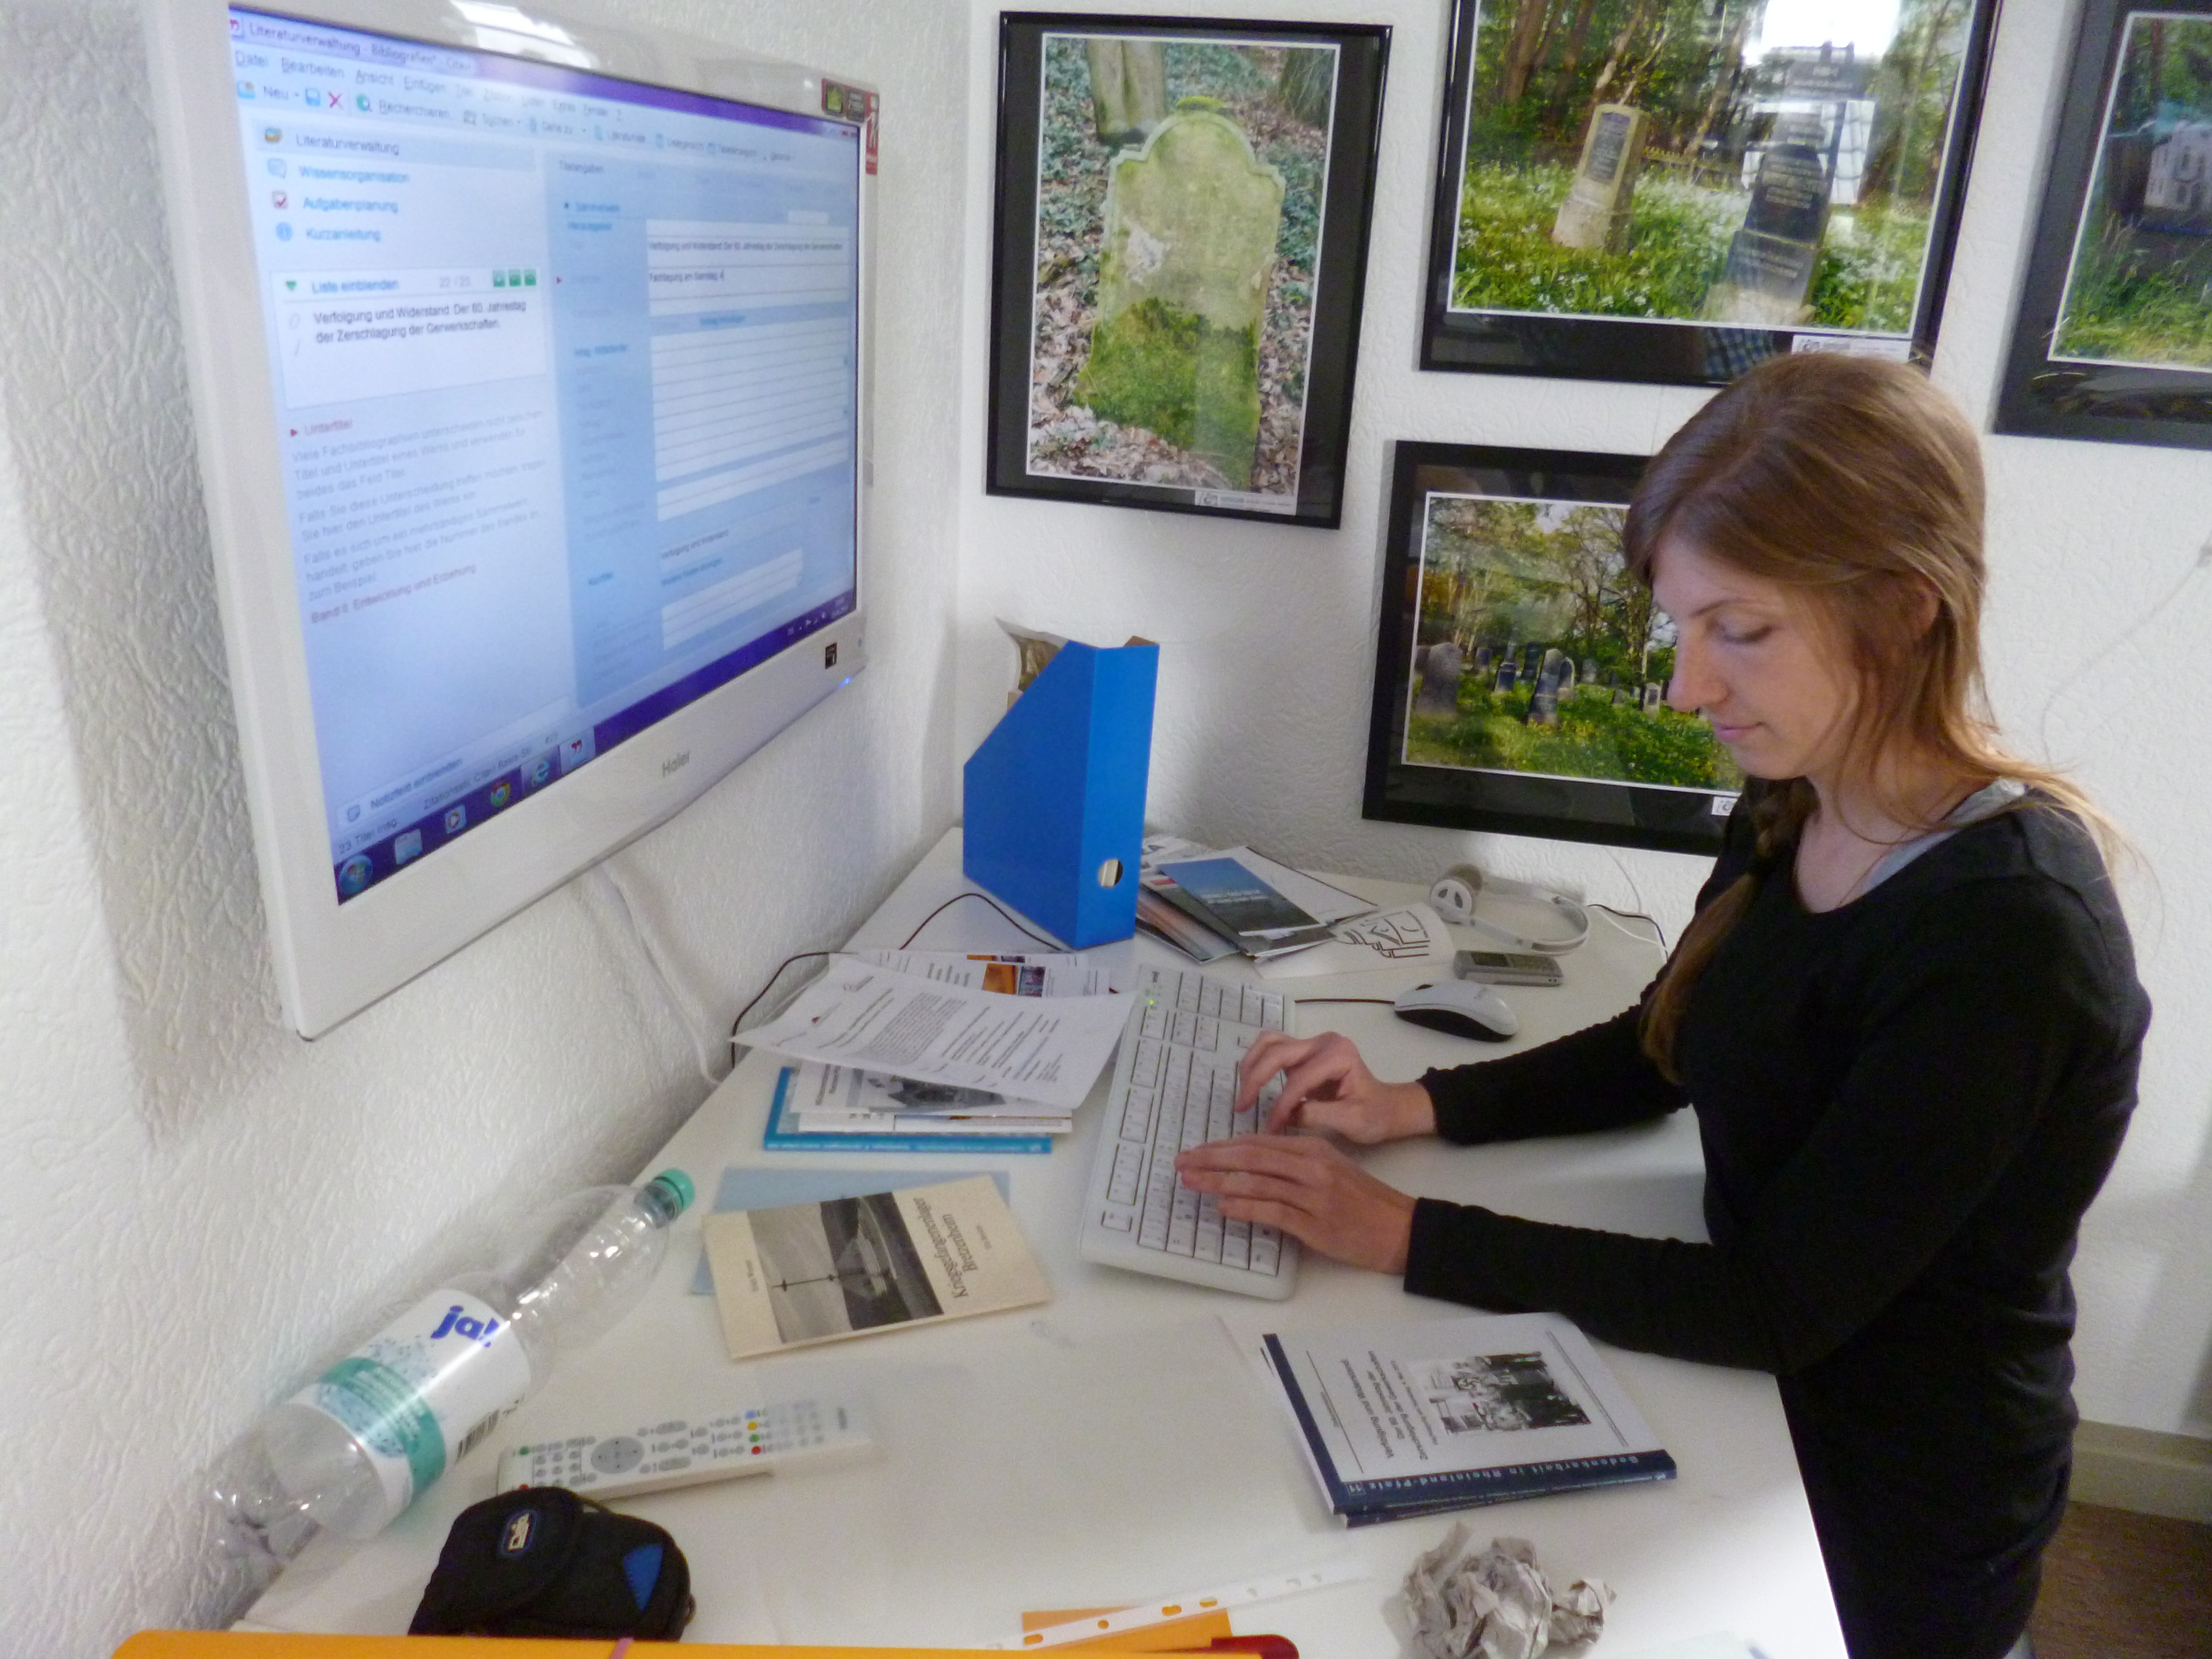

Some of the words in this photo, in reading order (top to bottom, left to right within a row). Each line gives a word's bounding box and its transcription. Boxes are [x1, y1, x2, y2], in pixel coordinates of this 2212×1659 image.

[235, 50, 269, 71] Datei
[281, 57, 344, 81] Bearbeiten
[355, 69, 394, 88] Ansicht
[404, 76, 446, 95] Einfügen
[264, 86, 290, 103] Neu
[296, 134, 399, 157] Literaturverwaltung
[298, 164, 410, 184] Wissensorganisation
[303, 196, 398, 214] Aufgabenplanung
[306, 227, 381, 241] Kurzanleitung
[311, 280, 338, 293] Liste
[341, 278, 399, 292] einblenden
[314, 310, 372, 326] Verfolgung
[375, 308, 394, 322] und
[454, 304, 470, 316] Der
[486, 301, 526, 313] Jahrestag
[316, 330, 334, 343] der
[337, 325, 406, 342] Zerschlagung
[409, 323, 424, 335] der
[292, 447, 318, 463] Viele
[422, 418, 484, 439] unterscheiden
[304, 417, 353, 436] Untertitel
[294, 466, 317, 481] Titel
[321, 461, 342, 476] und
[346, 452, 390, 471] Untertitel
[392, 447, 418, 462] eines
[451, 438, 468, 450] und
[296, 481, 334, 500] beides
[337, 476, 357, 491] das
[359, 471, 382, 486] Feld
[299, 506, 325, 523] Falls
[329, 501, 347, 517] Sie
[349, 495, 377, 512] diese
[380, 477, 454, 504] Unterscheidung
[456, 471, 482, 486] treffen
[302, 527, 320, 541] Sie
[323, 521, 344, 536] hier
[346, 516, 366, 529] den
[414, 500, 430, 513] des
[304, 548, 331, 565] Falls
[333, 543, 347, 557] es
[350, 537, 371, 553] sich
[374, 533, 390, 546] um
[392, 528, 408, 541] ein
[352, 551, 385, 570] geben
[386, 547, 401, 561] Sie
[404, 541, 422, 556] hier
[424, 537, 438, 550] die
[441, 526, 478, 545] Nummer
[309, 585, 332, 602] zum
[352, 583, 412, 611] Entwicklung
[414, 577, 431, 591] und
[434, 563, 476, 585] Erziehung
[339, 840, 352, 856] 23
[914, 1197, 969, 1299] Kriegsgefangenenlager
[943, 1213, 978, 1272] Bretzenheim
[430, 1305, 499, 1348] ja!
[1362, 1400, 1374, 1415] und
[1371, 1416, 1394, 1458] Verfolgung
[1401, 1414, 1428, 1460] Zerschlagung
